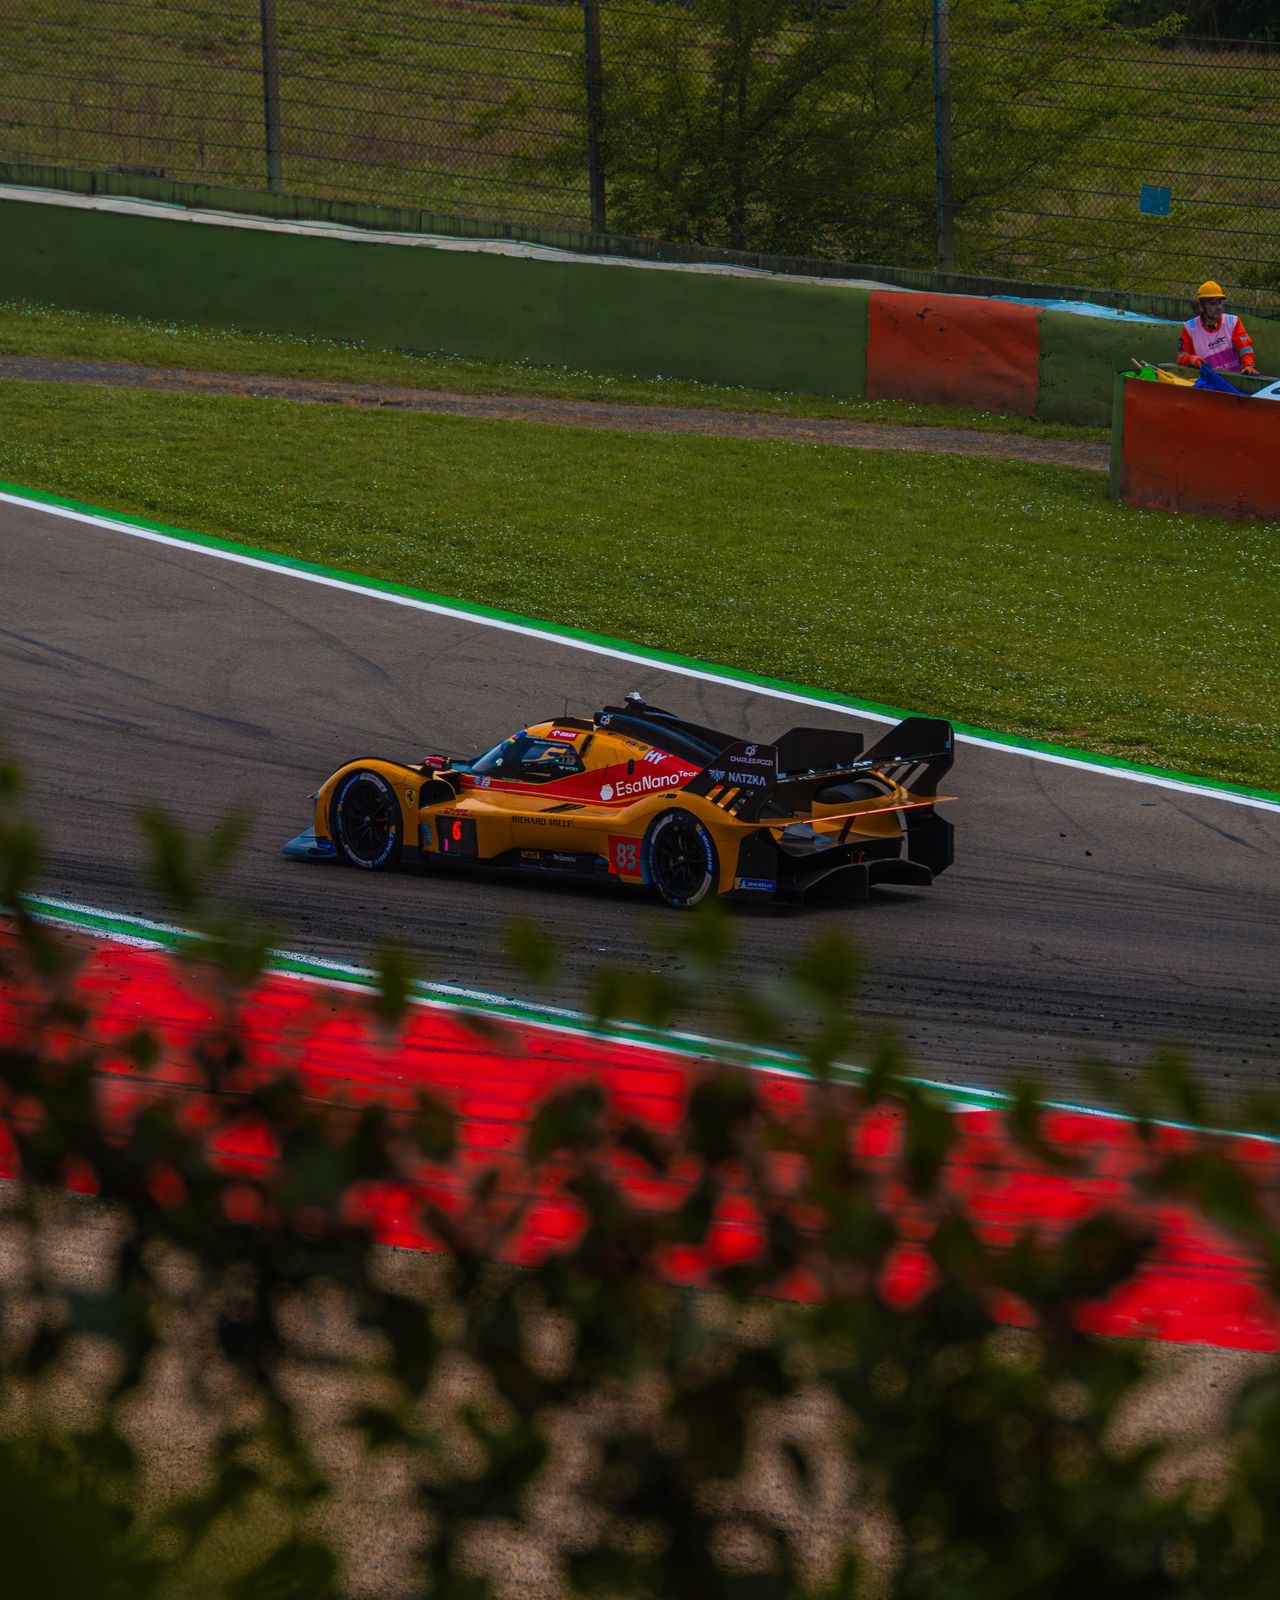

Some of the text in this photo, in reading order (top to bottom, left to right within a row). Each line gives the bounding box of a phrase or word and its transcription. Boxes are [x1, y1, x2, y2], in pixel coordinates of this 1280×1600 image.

[643, 750, 668, 764] HY
[730, 755, 756, 764] CHARLES
[728, 771, 767, 786] NATZKA
[512, 815, 573, 828] RICHARD MILLE
[450, 819, 463, 841] 6
[615, 843, 637, 869] 83
